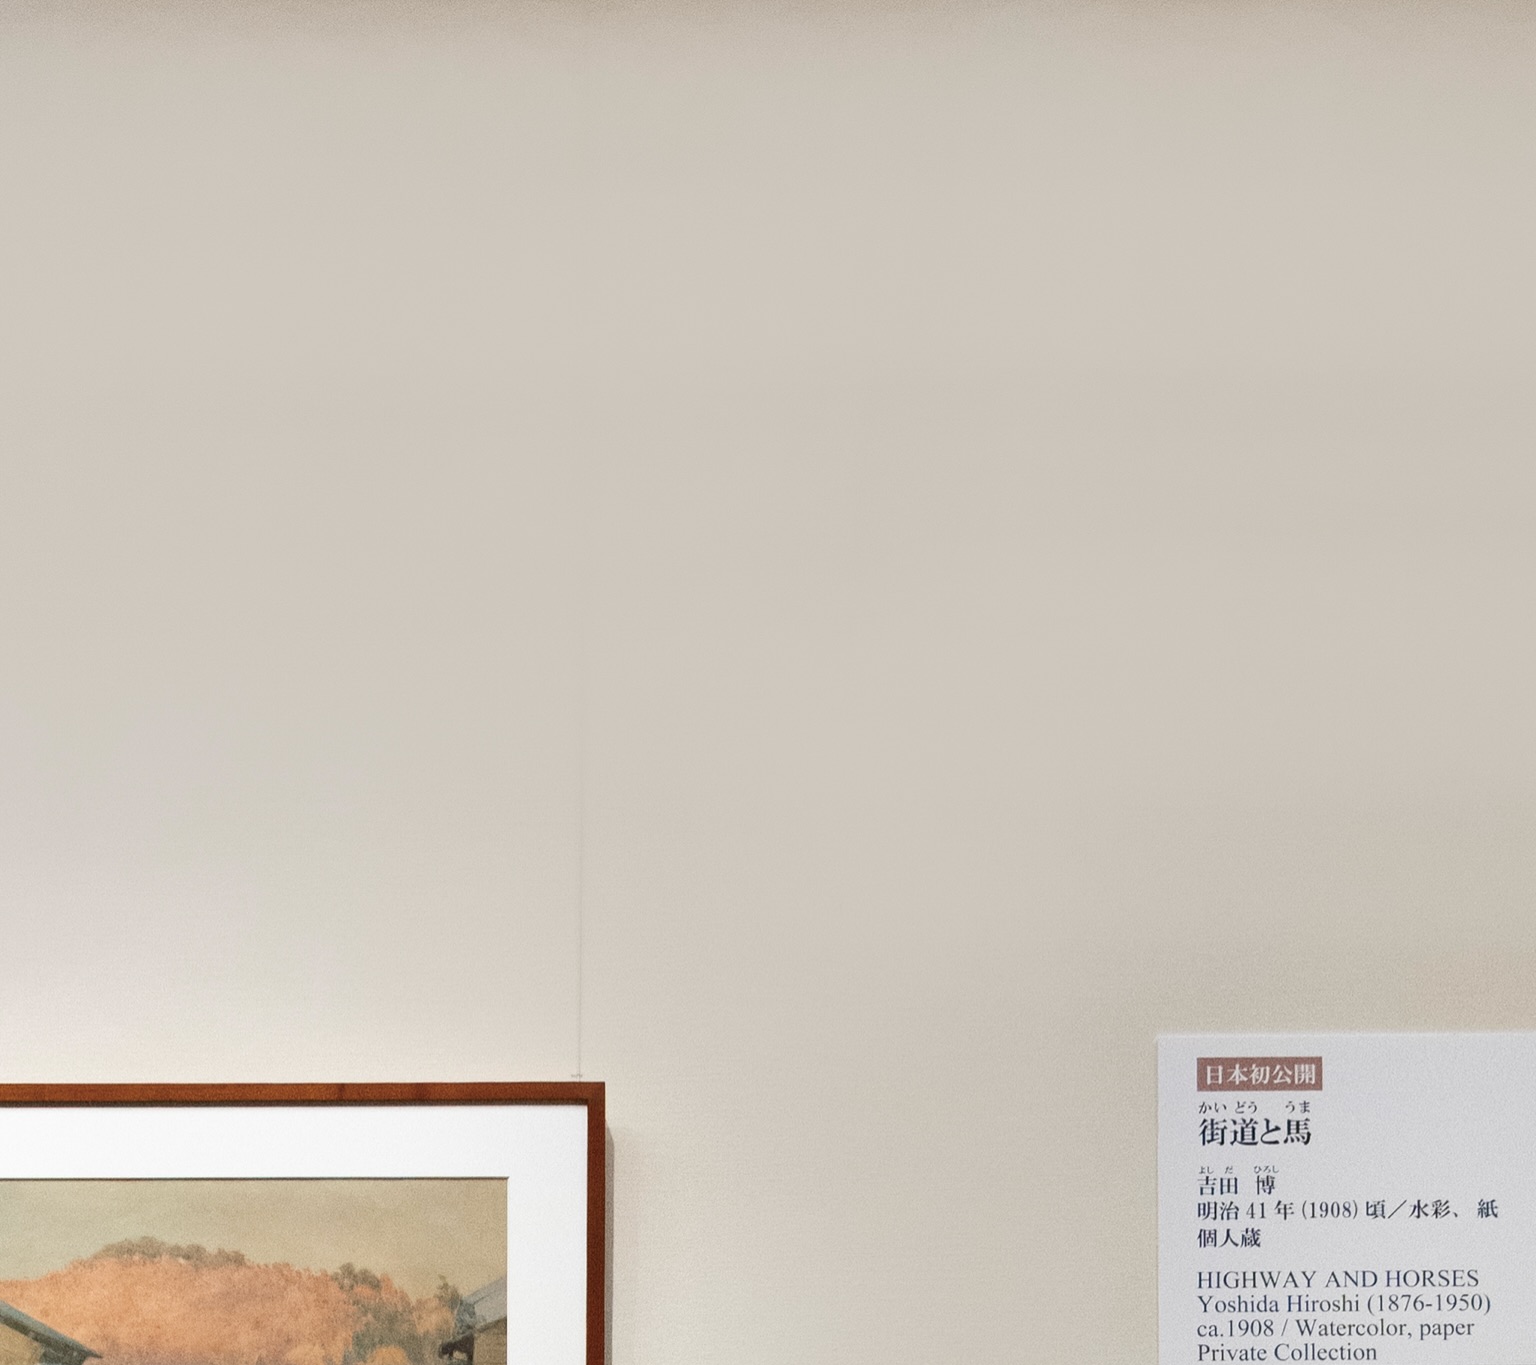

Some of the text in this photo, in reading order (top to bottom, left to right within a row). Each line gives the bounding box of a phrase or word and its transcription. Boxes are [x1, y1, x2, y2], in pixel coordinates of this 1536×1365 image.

[1207, 1064, 1315, 1085] 日本初公開
[1199, 1101, 1310, 1114] かい どう うま
[1199, 1118, 1311, 1146] 街道と馬
[1199, 1166, 1214, 1174] よし
[1254, 1165, 1279, 1174] ひろし
[1200, 1175, 1275, 1195] 吉田 博
[1198, 1228, 1260, 1248] 個人蔵
[1198, 1270, 1478, 1288] HIGHWAY AND HORSES
[1198, 1294, 1490, 1314] Yoshida Hiroshi (1876-1950)
[1197, 1318, 1474, 1340] ca.1908 / Watercolor, paper
[1199, 1343, 1376, 1361] Private Collection
